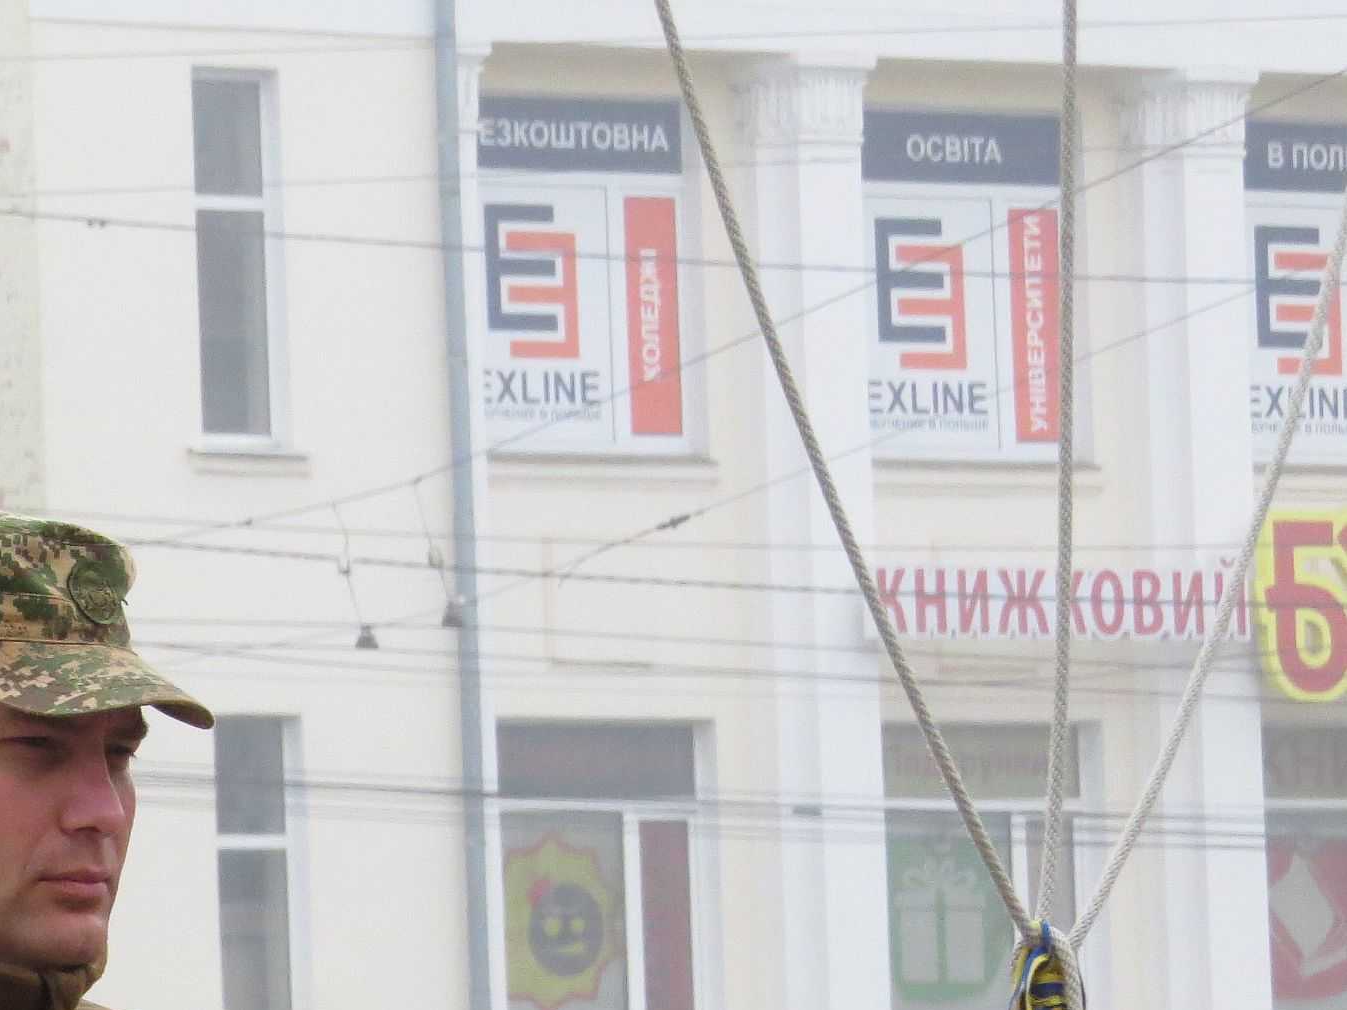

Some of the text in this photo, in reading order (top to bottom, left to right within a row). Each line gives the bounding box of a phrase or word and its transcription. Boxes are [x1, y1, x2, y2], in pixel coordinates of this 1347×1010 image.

[906, 133, 1002, 164] ОСВІТА
[1267, 141, 1347, 172] В ПОЛ
[1023, 214, 1048, 433] УНІВЕРСИТЕТИ
[868, 380, 988, 415] EXLINE
[877, 520, 1347, 693] КНИЖКОВИЙ Б
